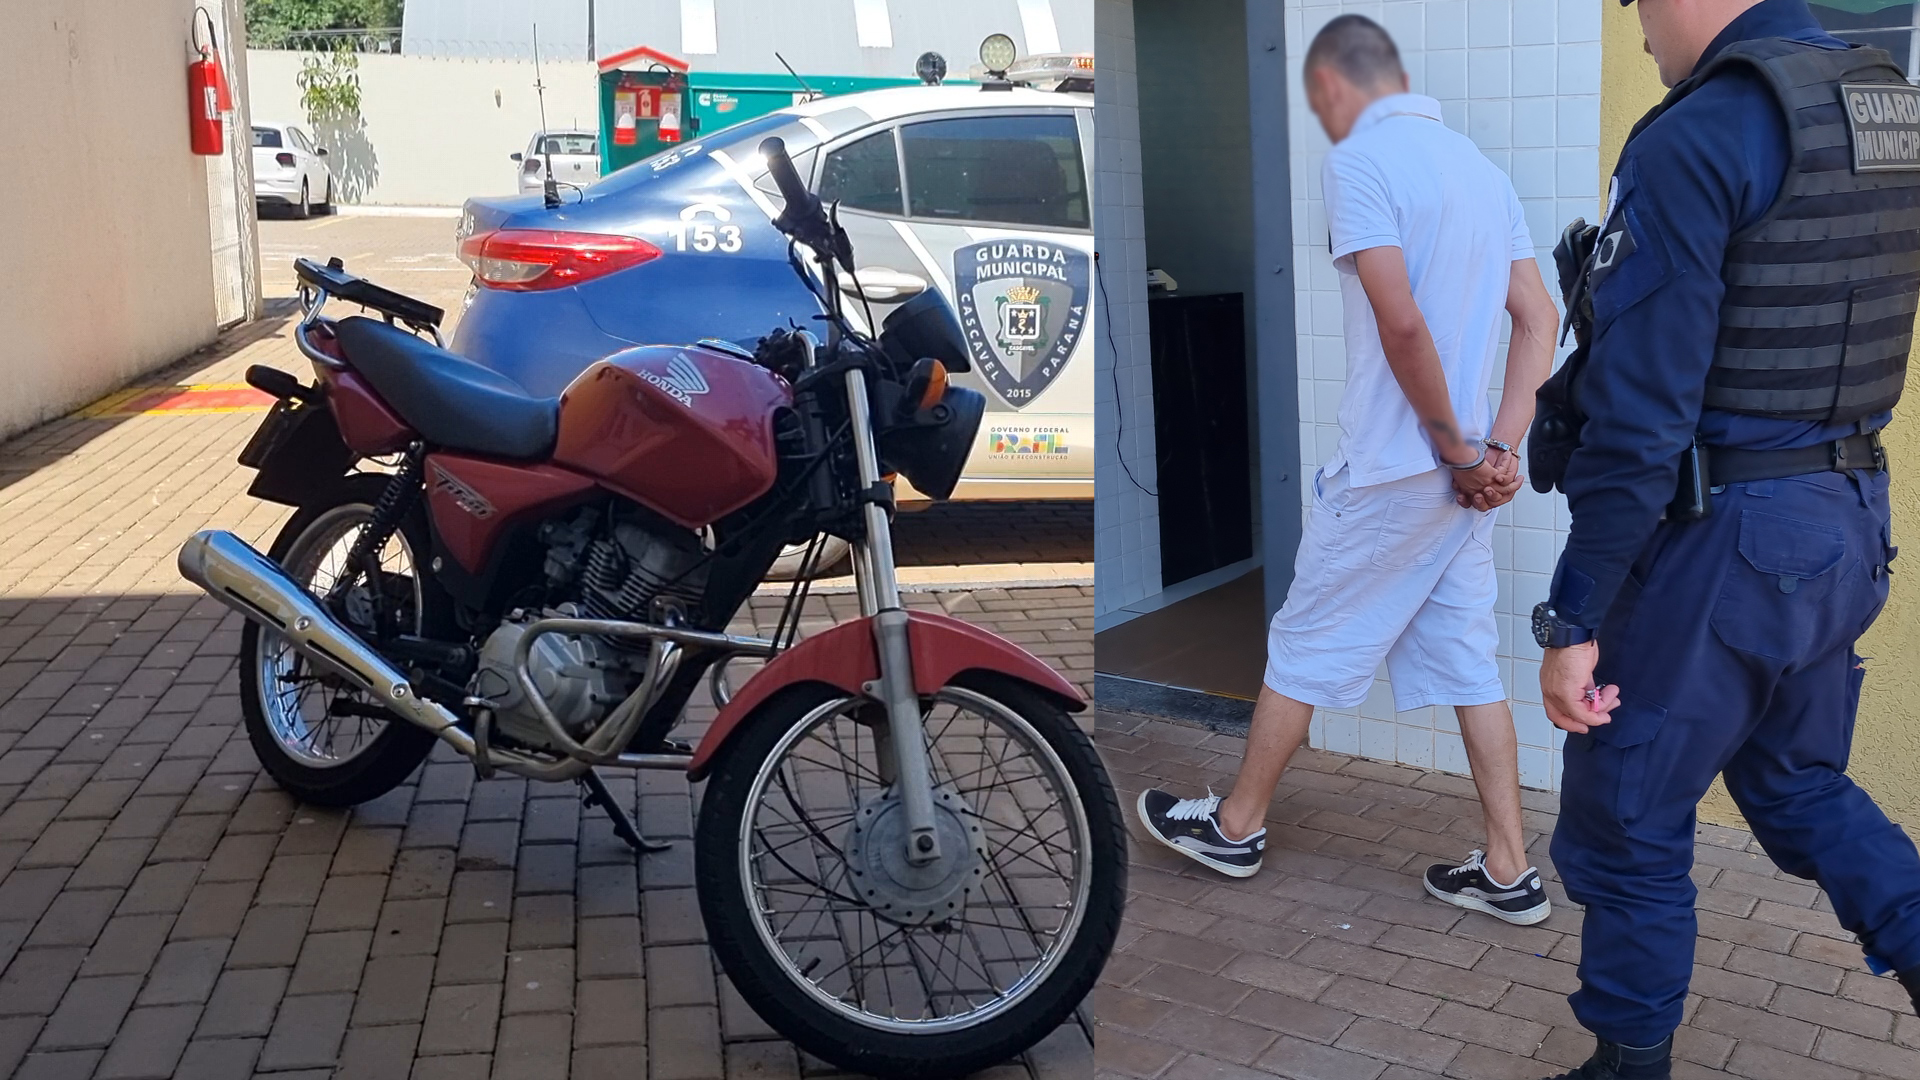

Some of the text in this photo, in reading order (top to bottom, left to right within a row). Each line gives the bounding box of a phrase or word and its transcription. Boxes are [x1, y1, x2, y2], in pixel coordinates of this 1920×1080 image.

[1849, 92, 1920, 124] GUARD
[668, 224, 743, 253] 153
[976, 244, 1066, 264] GUARDA
[976, 261, 1067, 281] MUNICIPAL
[961, 293, 1000, 381] CASCAVEL
[636, 369, 692, 408] HONDA
[1006, 388, 1031, 398] 2015
[989, 434, 1069, 453] BRASIL
